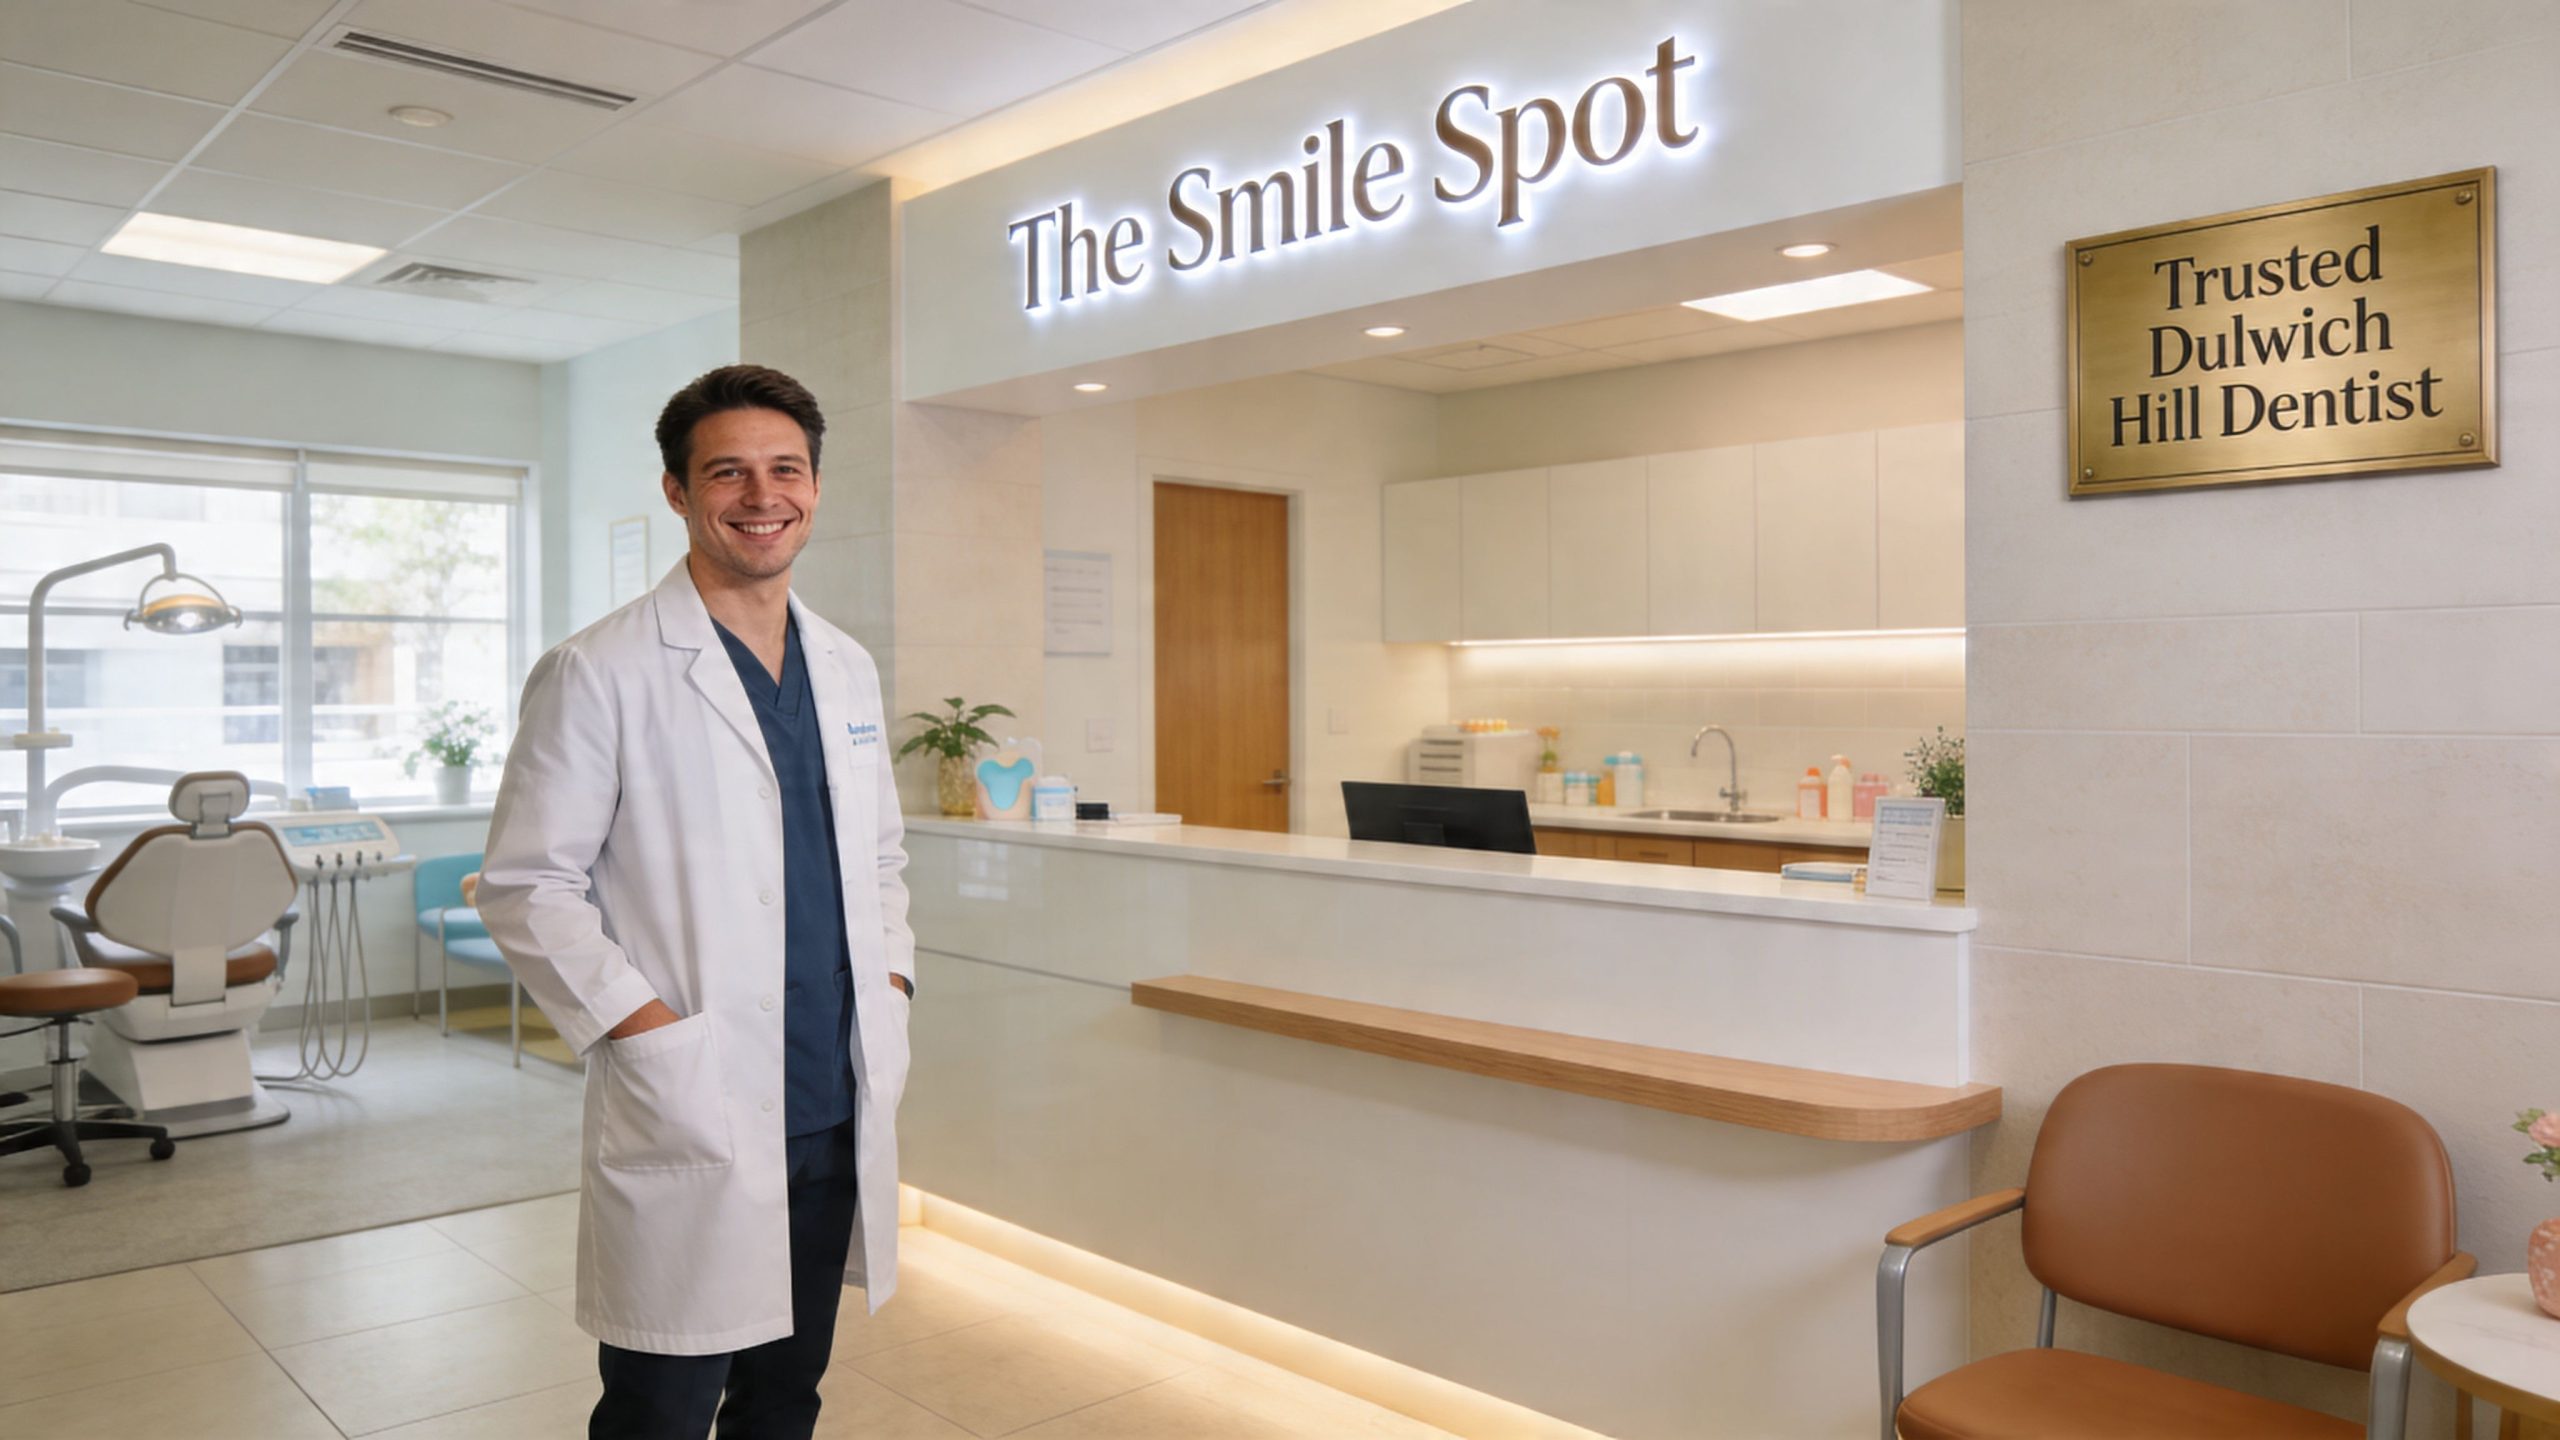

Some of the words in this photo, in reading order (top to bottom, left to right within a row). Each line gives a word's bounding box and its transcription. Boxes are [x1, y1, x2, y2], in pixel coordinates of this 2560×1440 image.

[1008, 201, 1145, 310] The
[1166, 117, 1405, 272] Smile
[1433, 35, 1700, 228] Spot
[2153, 224, 2383, 311] Trusted
[2148, 296, 2394, 378] Dulwich
[2110, 385, 2202, 447] Hill
[2220, 367, 2443, 438] Dentist
